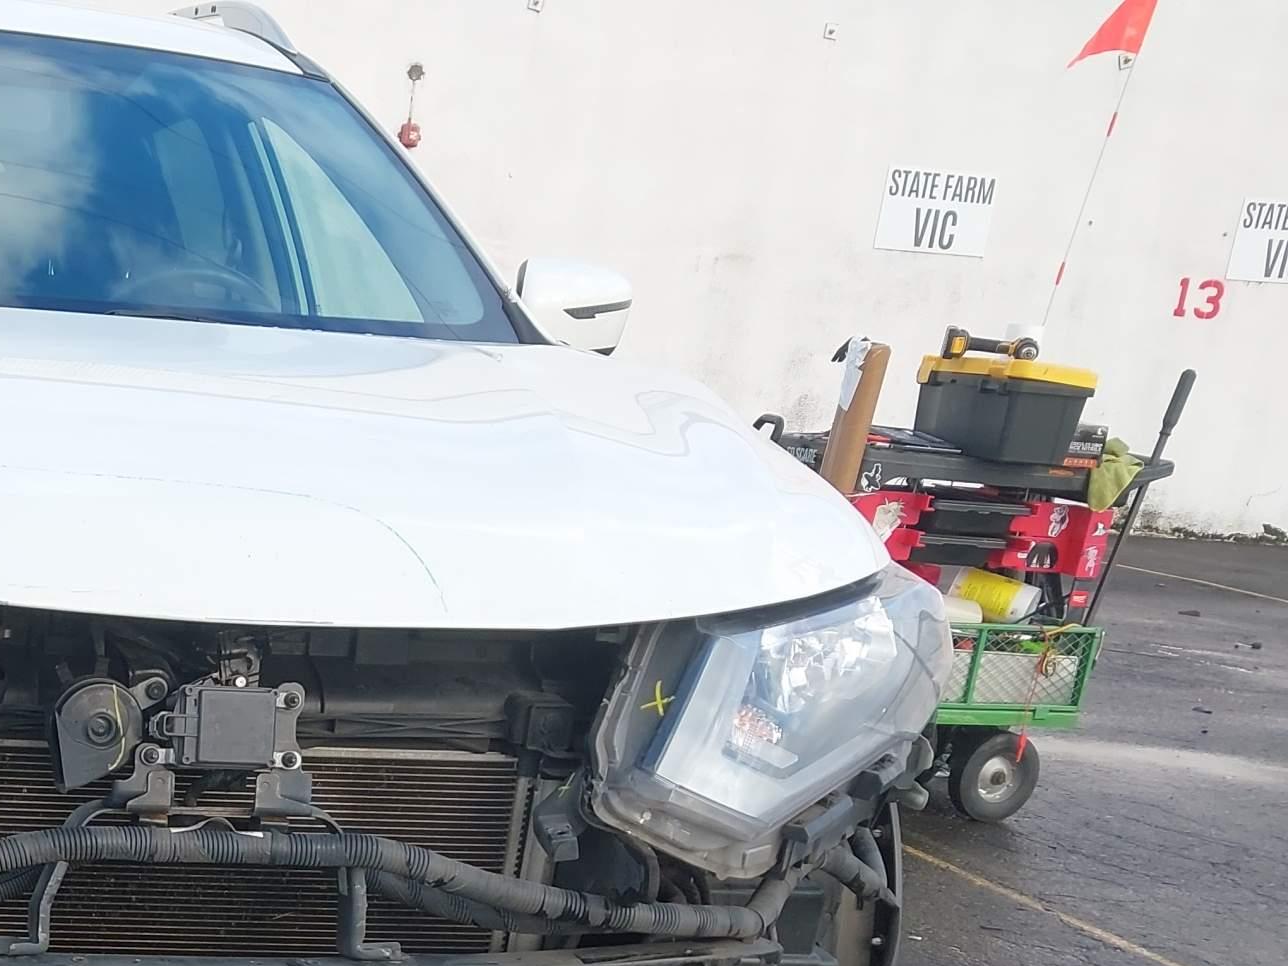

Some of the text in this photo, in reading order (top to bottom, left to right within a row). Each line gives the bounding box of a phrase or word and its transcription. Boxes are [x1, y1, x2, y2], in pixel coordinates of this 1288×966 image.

[889, 169, 996, 205] STATE FARM
[913, 207, 958, 250] VIC
[1173, 277, 1224, 319] 13
